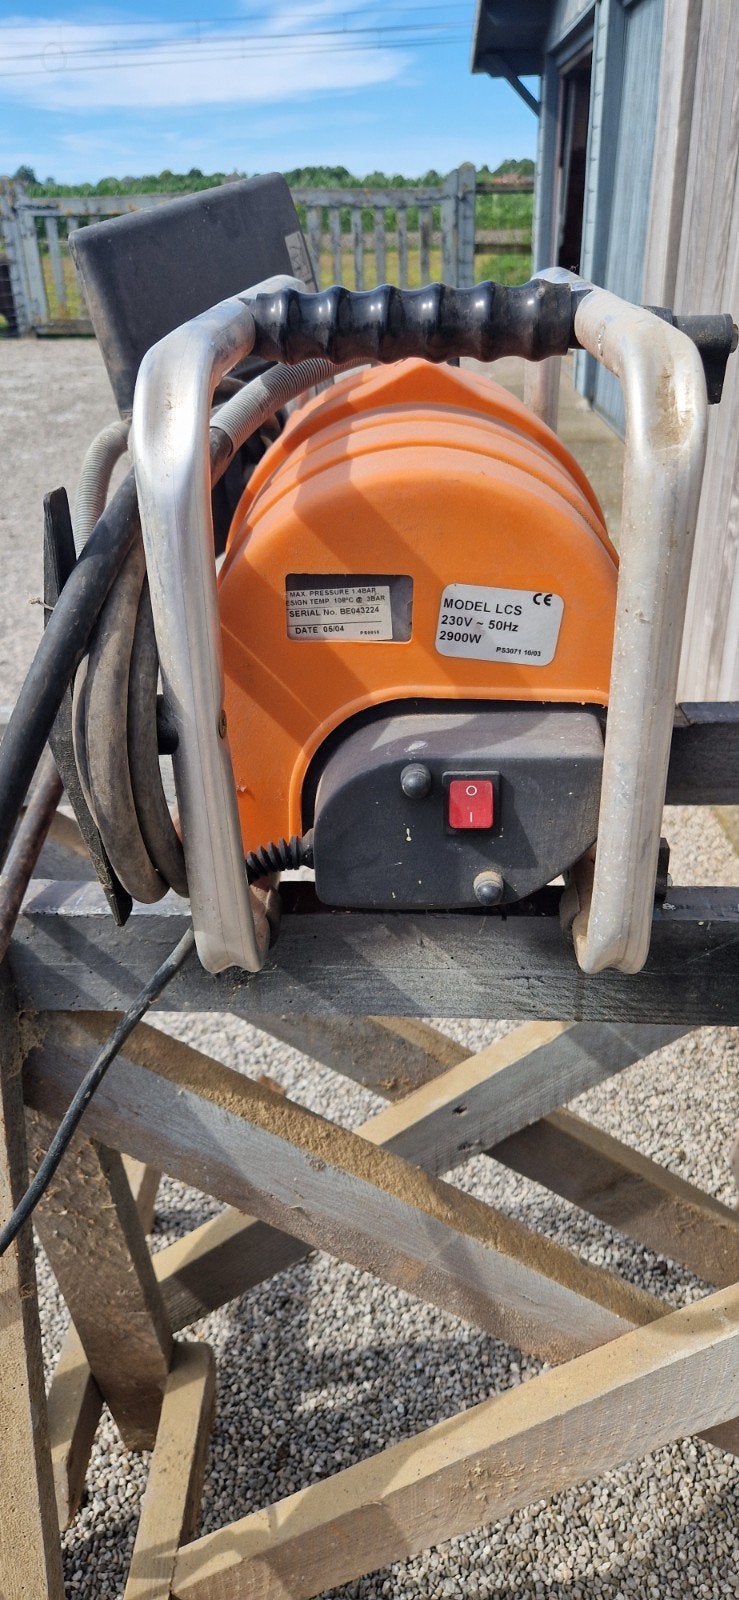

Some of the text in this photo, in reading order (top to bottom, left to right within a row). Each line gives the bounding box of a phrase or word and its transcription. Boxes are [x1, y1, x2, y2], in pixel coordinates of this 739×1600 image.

[289, 609, 321, 618] SERIAL
[340, 606, 379, 615] BE043224
[444, 598, 522, 616] MODEL LCS
[441, 615, 473, 626] 230V
[488, 620, 519, 632] 50Hz
[439, 631, 482, 643] 2900W
